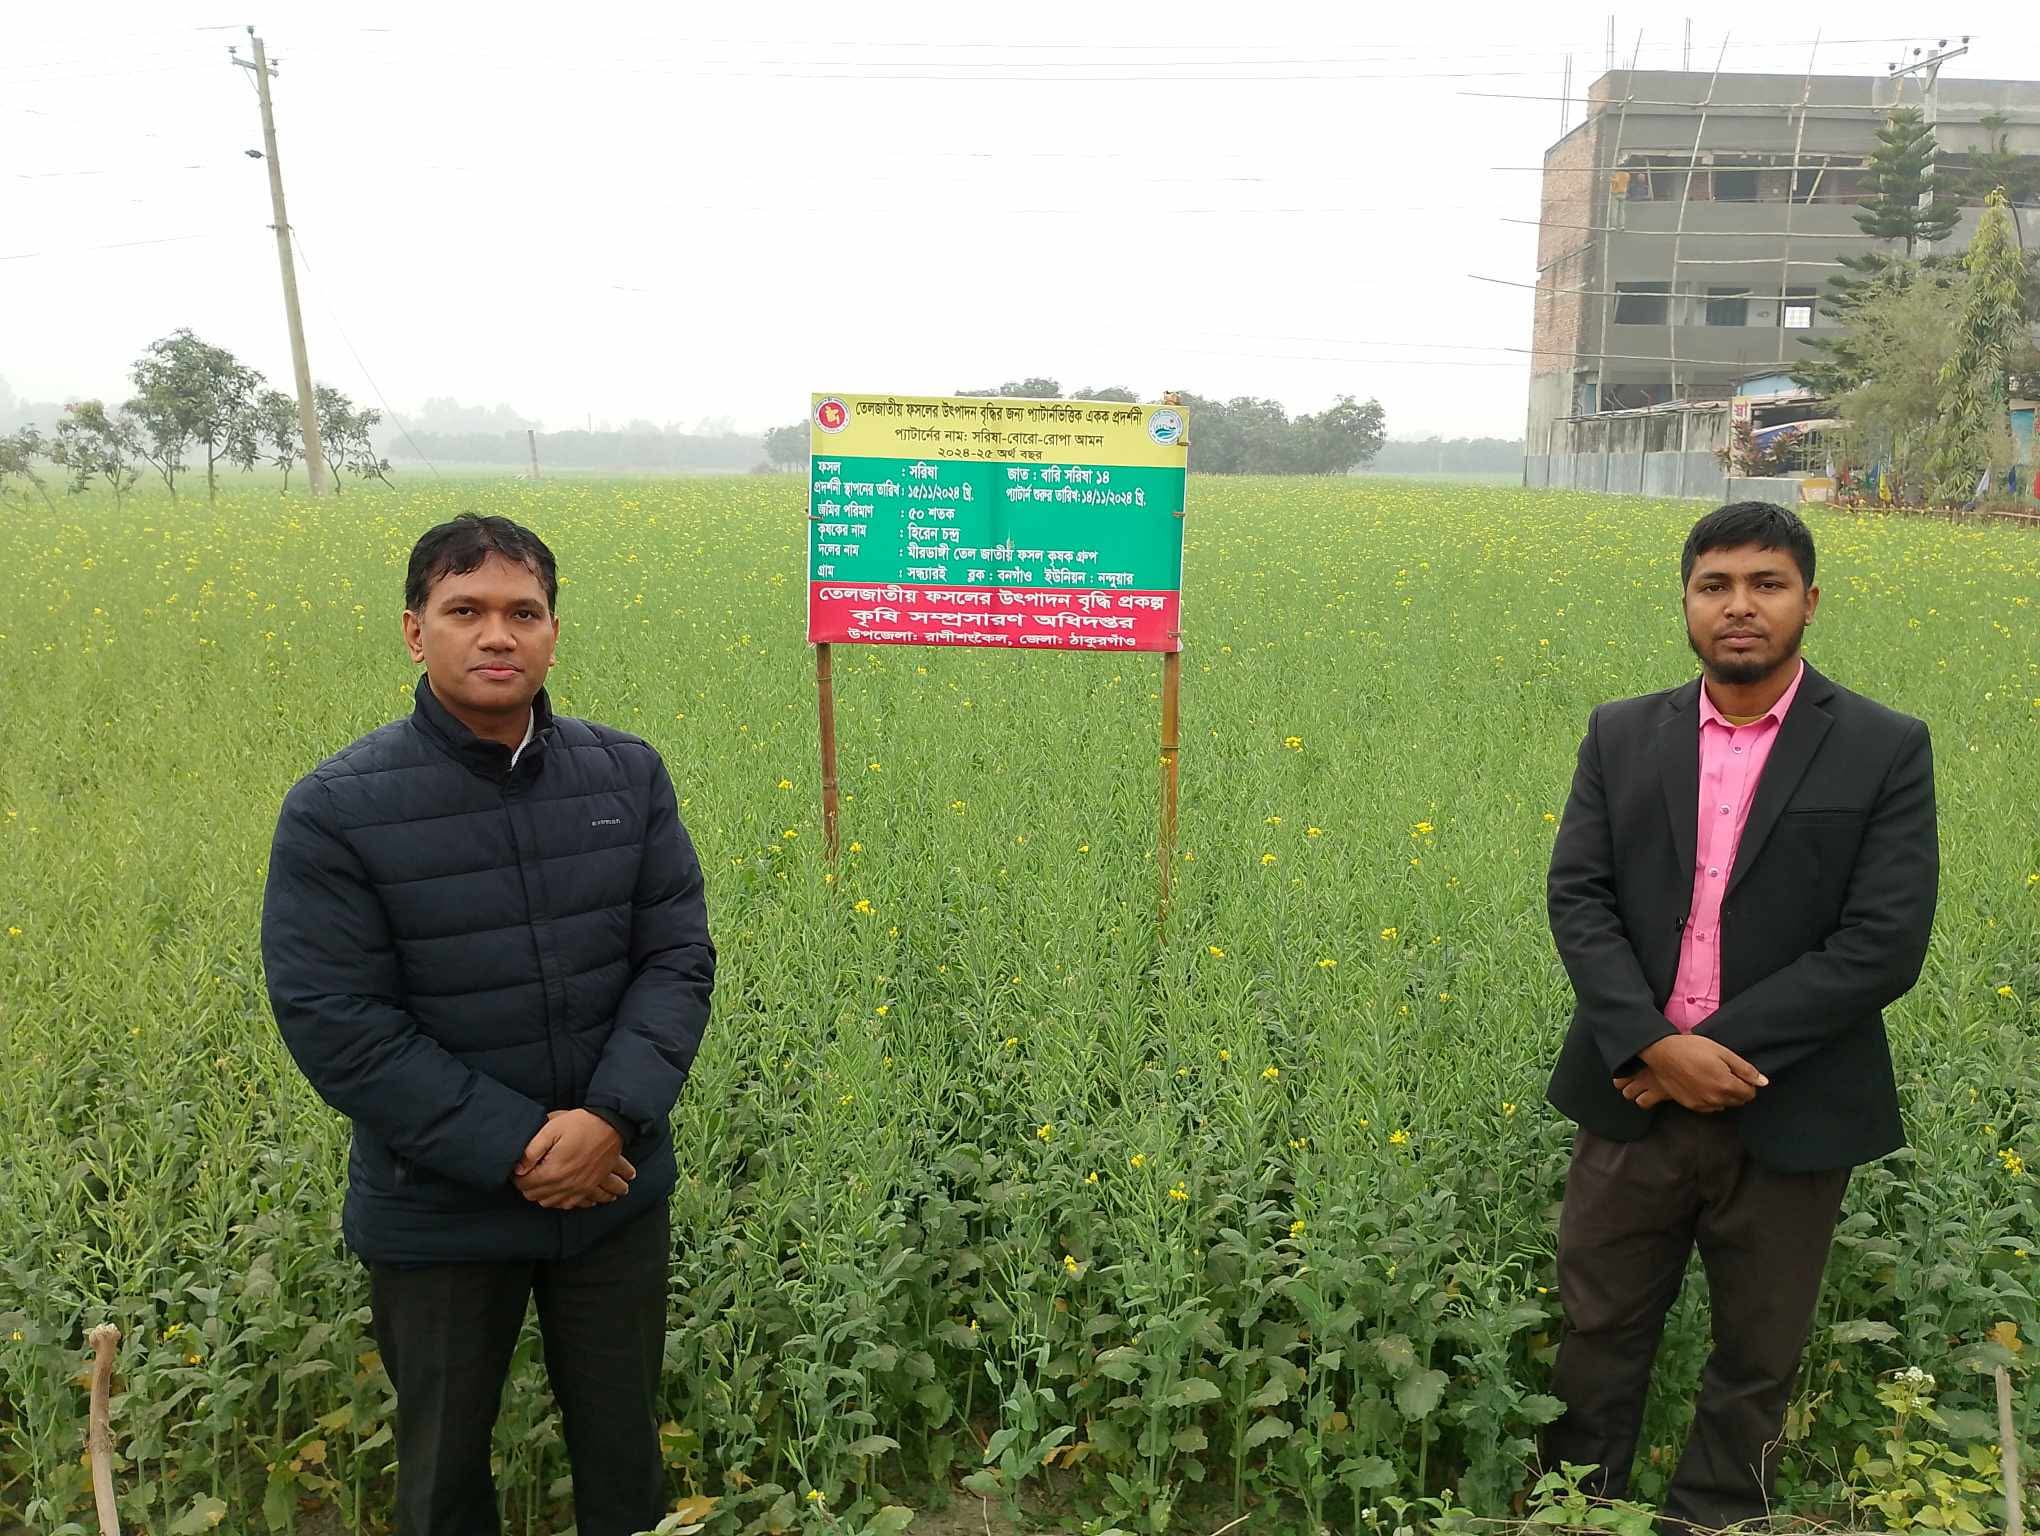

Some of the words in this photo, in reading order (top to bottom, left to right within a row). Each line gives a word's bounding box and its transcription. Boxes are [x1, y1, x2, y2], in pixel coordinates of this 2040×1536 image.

[856, 398, 903, 417] তেলজাতীয়
[906, 403, 939, 419] ফসলের
[942, 401, 977, 421] উৎপাদন
[980, 401, 1004, 425] বৃদ্ধির
[1005, 407, 1024, 422] জন্য
[1086, 409, 1109, 425] একক
[1112, 406, 1143, 427] প্রদর্শনী
[895, 425, 941, 441] প্যাটার্নের
[1074, 434, 1104, 448] আমন
[938, 447, 993, 458] ২০২৪-২৫
[997, 447, 1016, 459] অর্থ
[1020, 450, 1042, 461] বছর
[817, 461, 842, 475] ফসল
[909, 461, 938, 480] সরিষা
[1007, 467, 1030, 482] জাত
[1040, 464, 1061, 483] বারি
[1064, 466, 1093, 484] সরিষা
[1096, 470, 1110, 484] ১৪
[817, 499, 841, 517] জমির
[843, 500, 874, 518] পরিমাণ
[908, 507, 925, 520] ৫০
[928, 507, 956, 521] শতক
[817, 522, 849, 542] কৃষকের
[851, 523, 867, 538] নাম
[907, 522, 939, 542] হিরেন
[941, 527, 961, 543] চন্দ্র
[817, 543, 841, 557] দলের
[843, 543, 860, 557] নাম
[953, 547, 977, 561] তেল
[980, 544, 1014, 562] জাতীয়
[1017, 549, 1044, 563] ফসল
[1047, 549, 1075, 567] কৃষক
[817, 563, 835, 578] গ্রাম
[1043, 566, 1087, 585] ইউনিয়ন
[819, 585, 918, 605] তেলজাতীয়
[924, 590, 993, 606] ফসলের
[999, 589, 1072, 609] উৎপাদন
[1076, 591, 1113, 613] বৃদ্ধি
[1117, 594, 1168, 611] প্রকল্প
[848, 607, 900, 628] কৃষি
[908, 611, 1027, 628] সম্প্রসারণ
[1031, 611, 1137, 630] অধিদপ্তর
